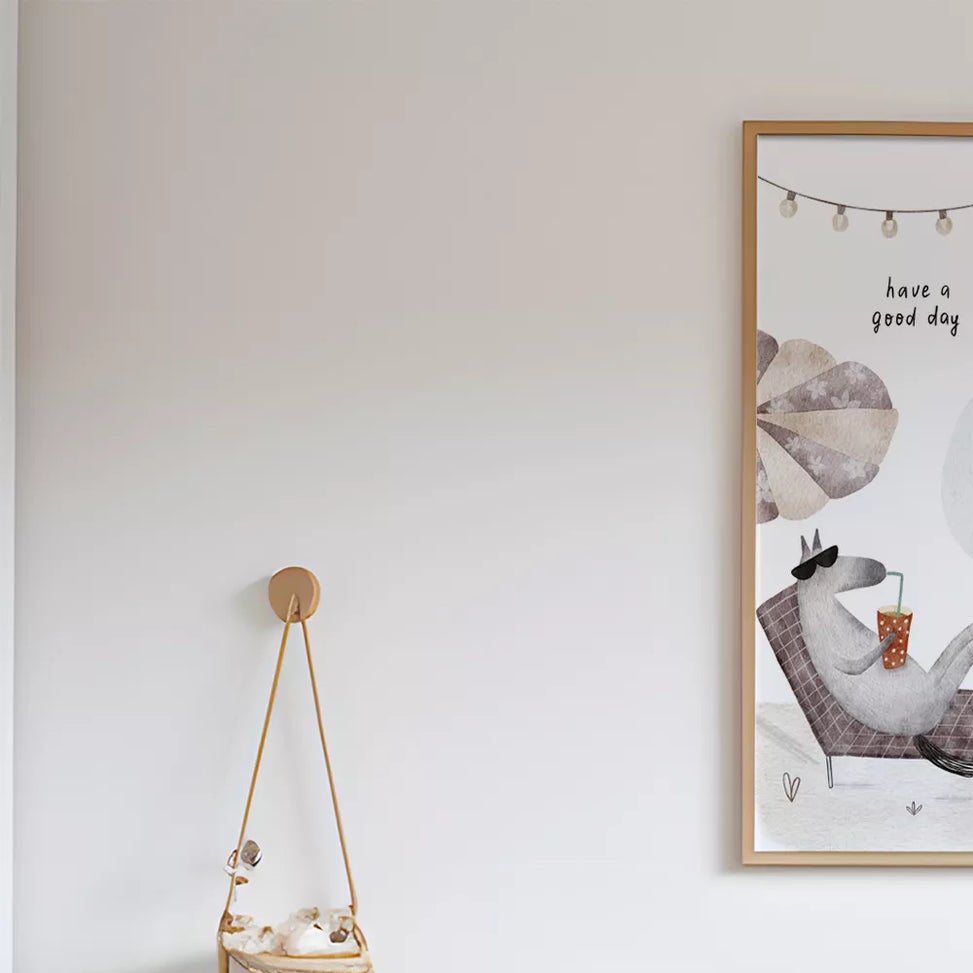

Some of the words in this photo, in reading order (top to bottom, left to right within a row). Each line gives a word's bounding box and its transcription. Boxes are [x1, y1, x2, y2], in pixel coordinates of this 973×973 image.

[886, 276, 930, 299] have
[940, 284, 950, 299] a
[871, 306, 917, 334] good
[927, 305, 960, 337] day
